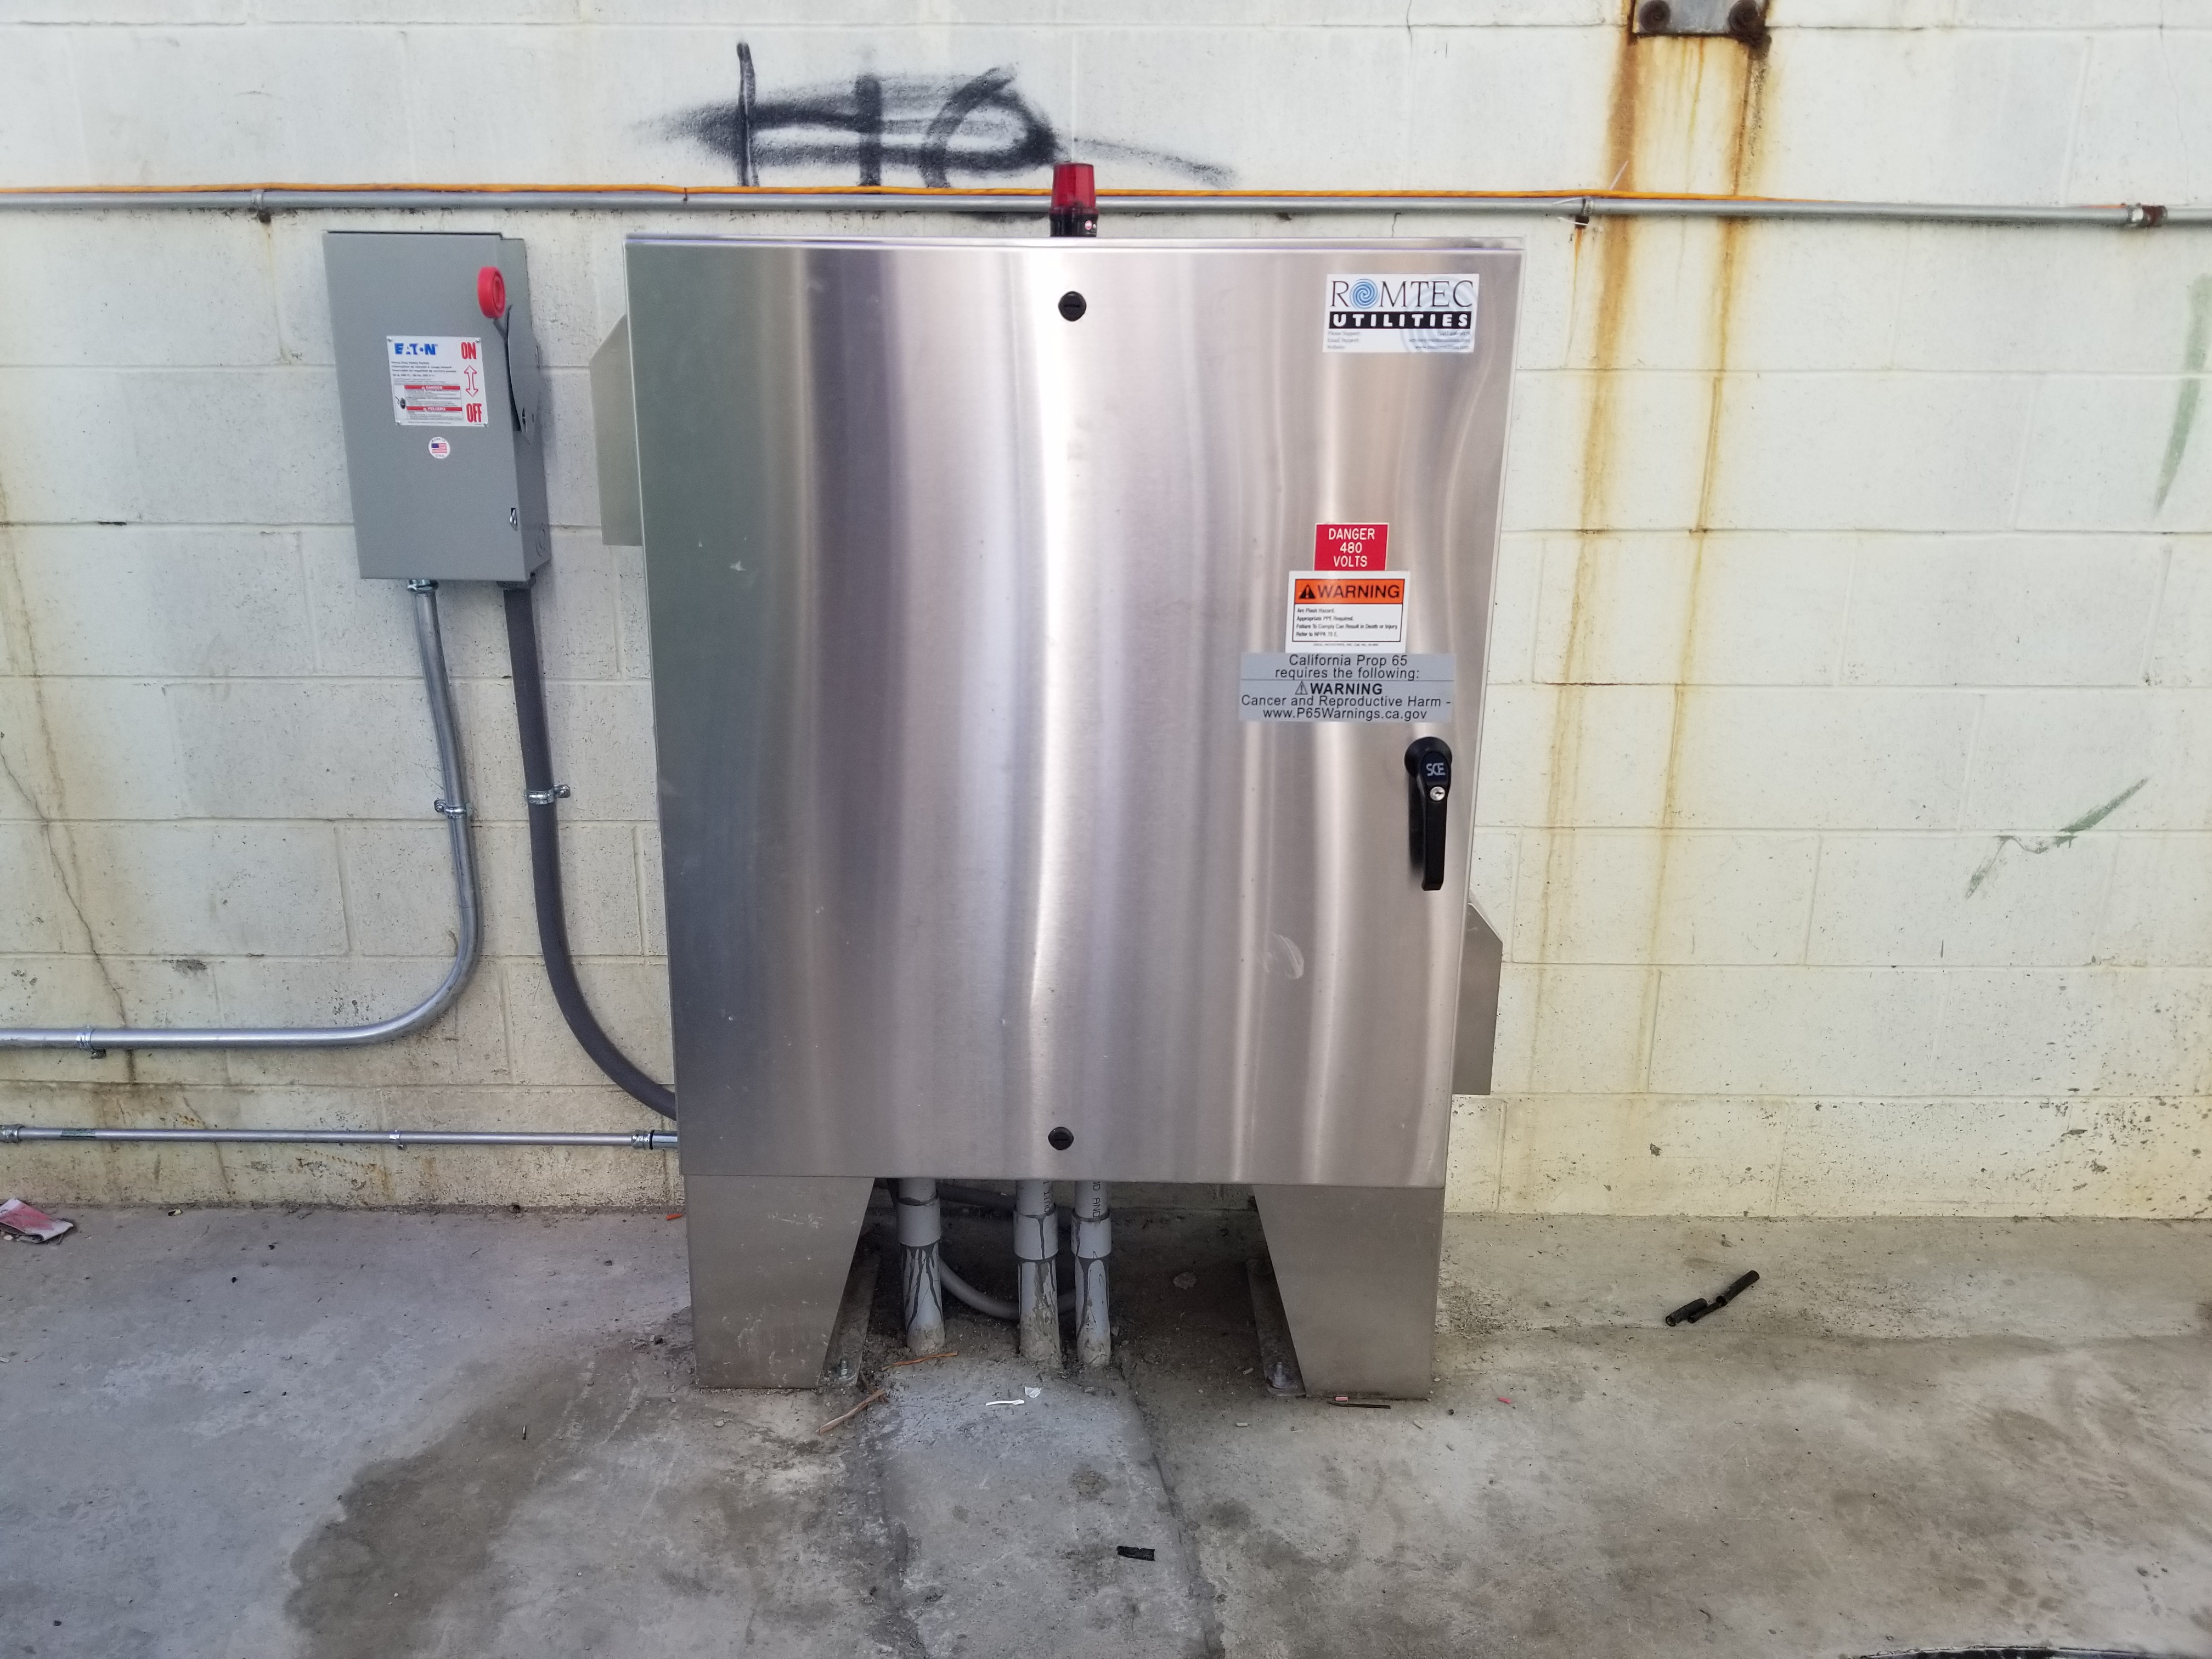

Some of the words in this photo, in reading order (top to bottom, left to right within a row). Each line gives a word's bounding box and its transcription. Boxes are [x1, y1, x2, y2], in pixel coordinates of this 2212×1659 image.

[1330, 279, 1473, 309] ROMTEC
[1333, 313, 1469, 328] UTILITIES
[460, 341, 477, 359] ON
[466, 403, 482, 422] OFF
[1328, 528, 1375, 540] DANGER
[1340, 542, 1363, 554] 480
[1333, 555, 1368, 567] VOLTS
[1318, 585, 1400, 599] WARNING
[1289, 654, 1351, 666] California
[1357, 654, 1387, 669] Prop
[1392, 655, 1408, 666] 65
[1275, 668, 1328, 680] requires
[1333, 667, 1352, 679] the
[1358, 667, 1420, 681] following:
[1310, 684, 1383, 695] WARNING
[1241, 695, 1286, 706] Cancer
[1291, 695, 1313, 706] and
[1319, 696, 1403, 709] Reproductive
[1408, 696, 1442, 707] Harm
[1262, 708, 1427, 721] www.P65Warnings.ca.gov
[1426, 762, 1446, 776] SCE
[1092, 1197, 1101, 1218] AND
